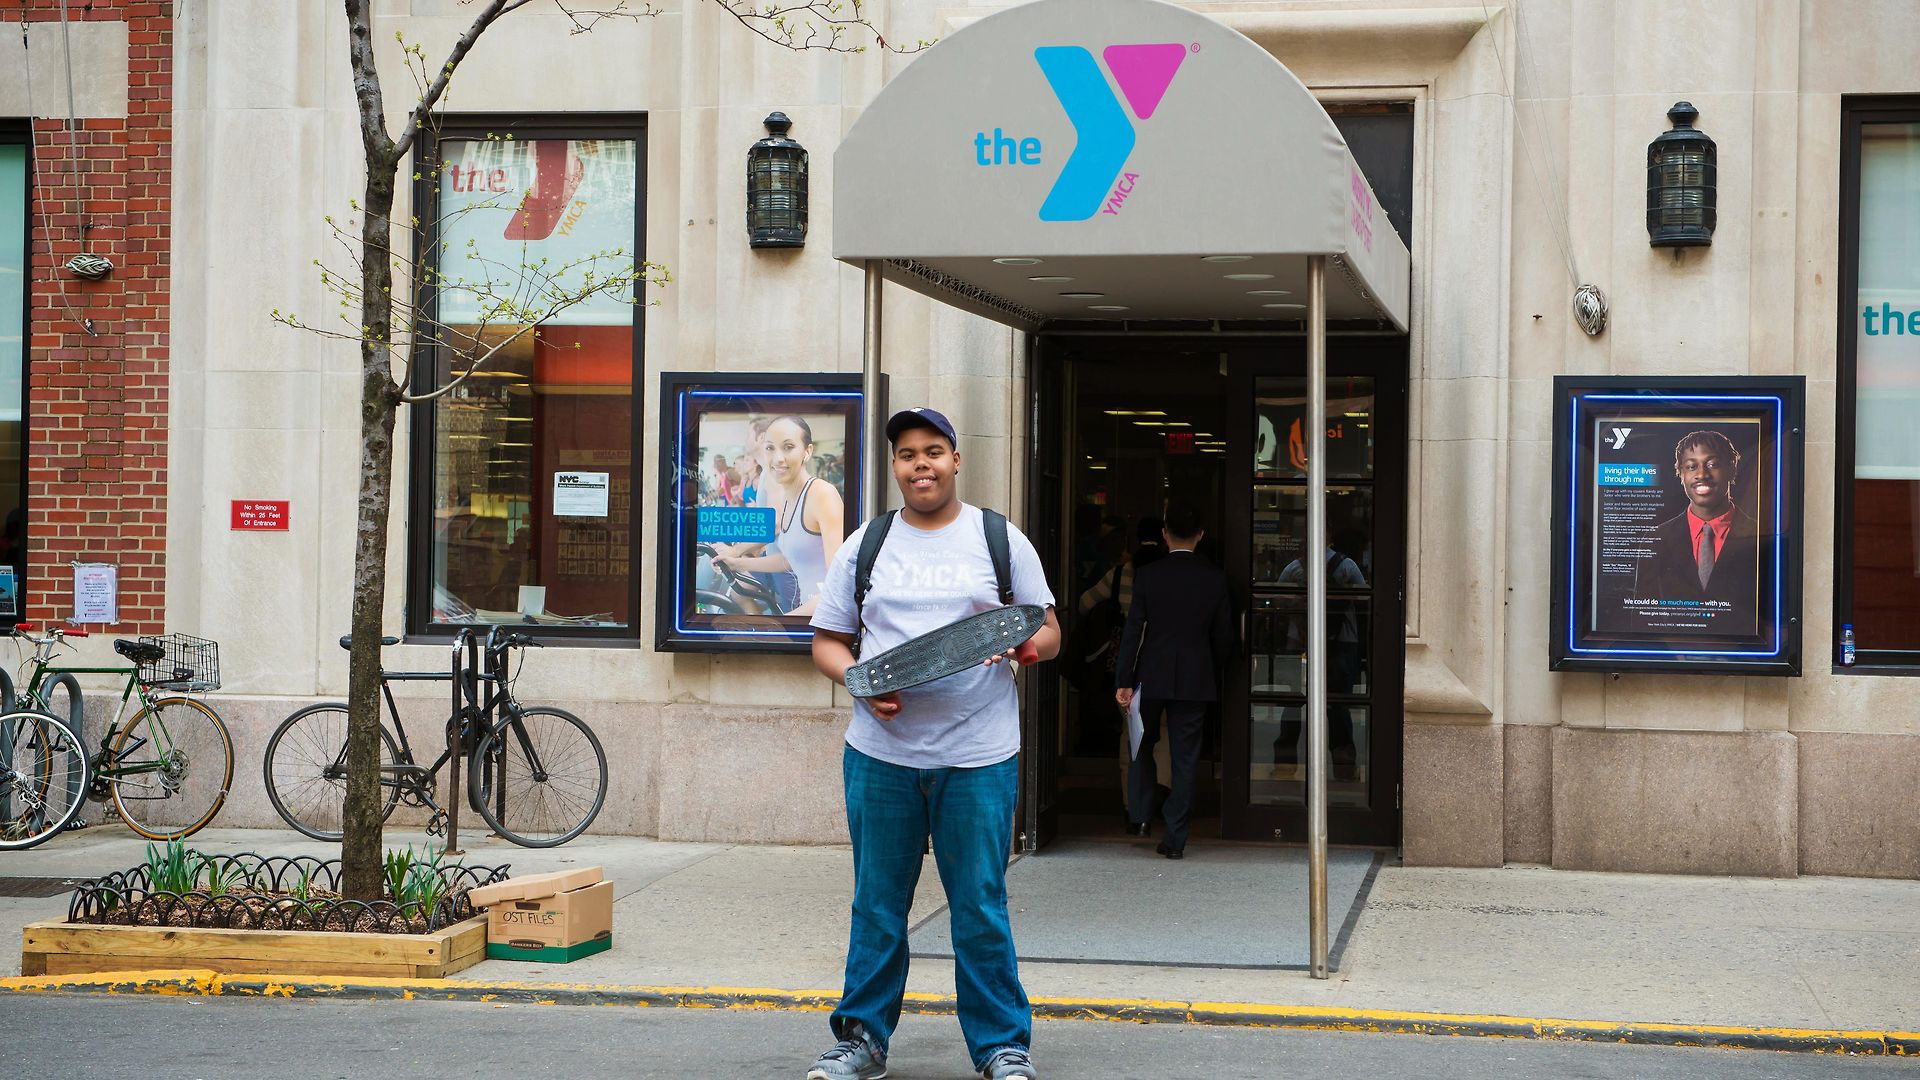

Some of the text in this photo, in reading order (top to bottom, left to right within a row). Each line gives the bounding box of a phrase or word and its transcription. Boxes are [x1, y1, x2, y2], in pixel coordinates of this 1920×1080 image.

[974, 128, 1041, 166] the
[451, 162, 506, 192] the
[1103, 171, 1139, 217] YMCA
[557, 199, 587, 237] YMCA
[1605, 466, 1622, 476] living
[1624, 466, 1640, 474] their
[1605, 476, 1632, 484] through
[700, 512, 765, 523] DISCOVER
[700, 525, 767, 537] WELLNESS
[889, 563, 974, 587] YMCA
[503, 912, 524, 924] OST
[528, 912, 554, 924] FILES
